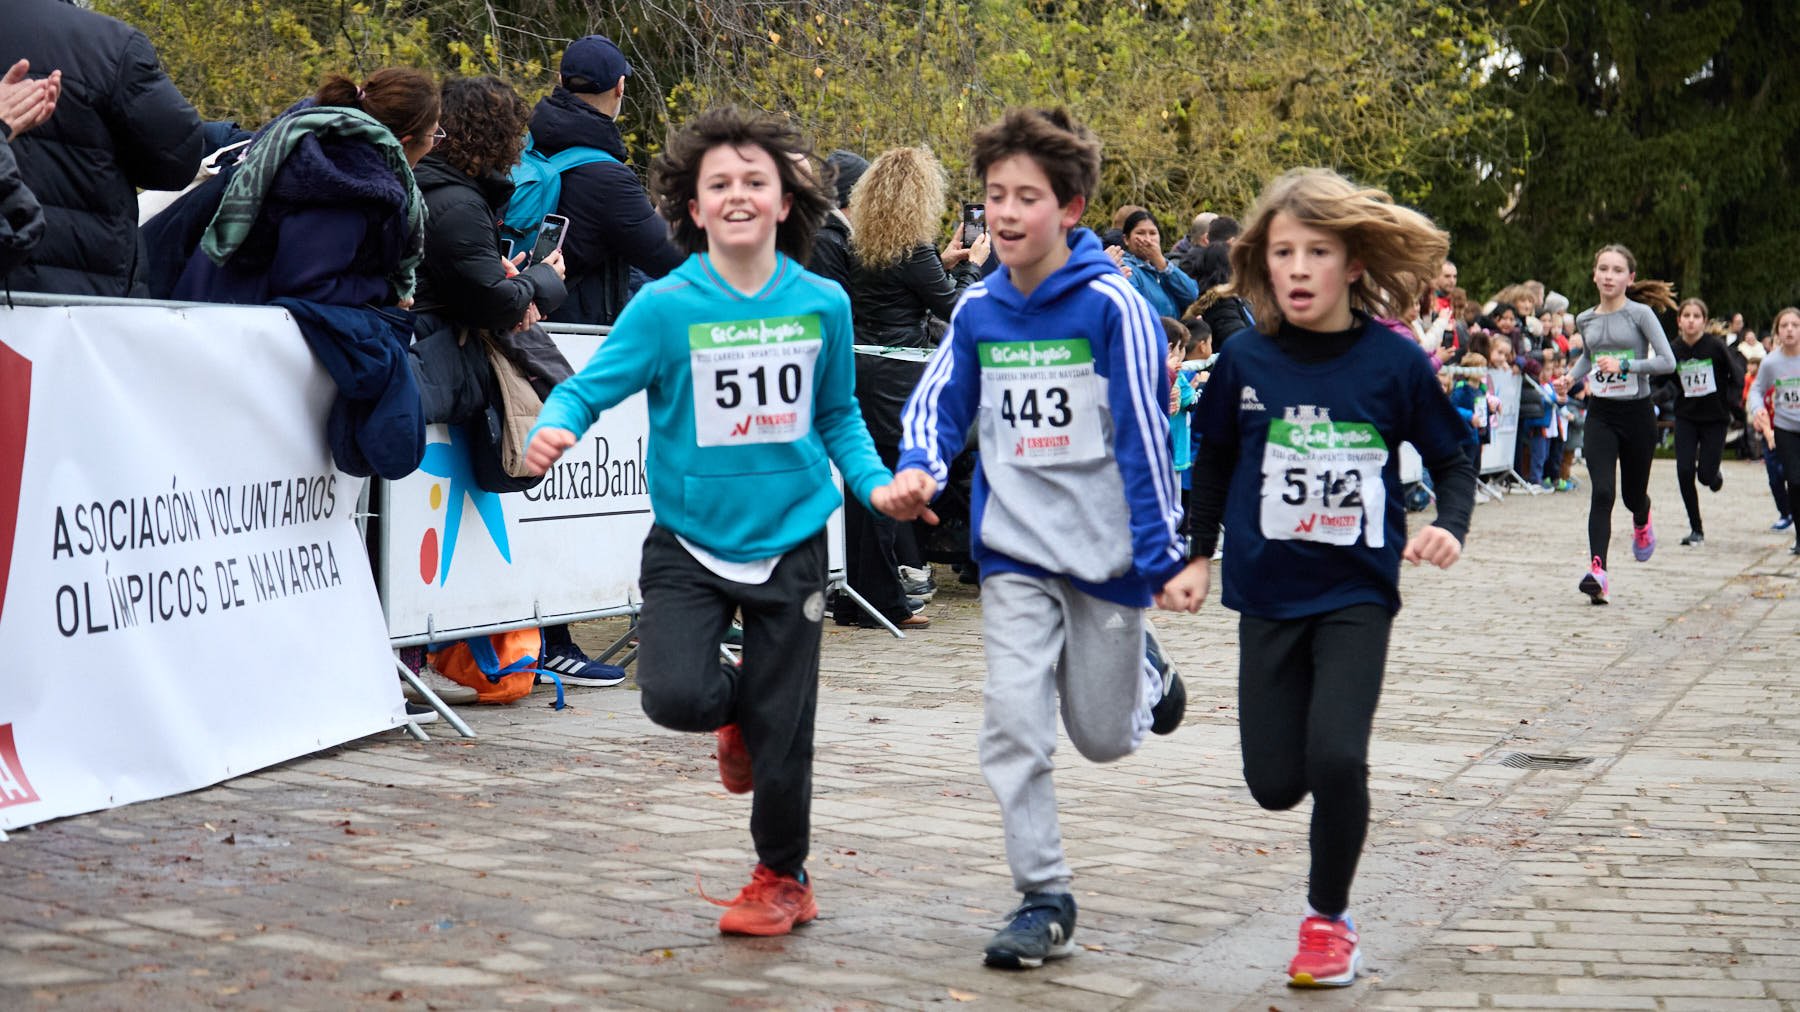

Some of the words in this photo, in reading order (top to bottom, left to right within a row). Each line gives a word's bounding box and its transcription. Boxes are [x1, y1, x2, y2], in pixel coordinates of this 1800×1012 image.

[714, 352, 745, 362] CARRERA
[1019, 371, 1047, 381] INFANTIL
[1059, 368, 1090, 379] NAVIDAD
[715, 364, 803, 409] 510
[1684, 373, 1707, 387] 747
[1001, 387, 1073, 429] 443
[1281, 467, 1363, 508] 512
[52, 472, 201, 560] ASOCIACIÓN
[201, 473, 337, 537] VOLUNTARIOS
[55, 559, 208, 638] OLÍMPICOS
[214, 558, 245, 610] DE
[247, 540, 342, 603] NAVARRA
